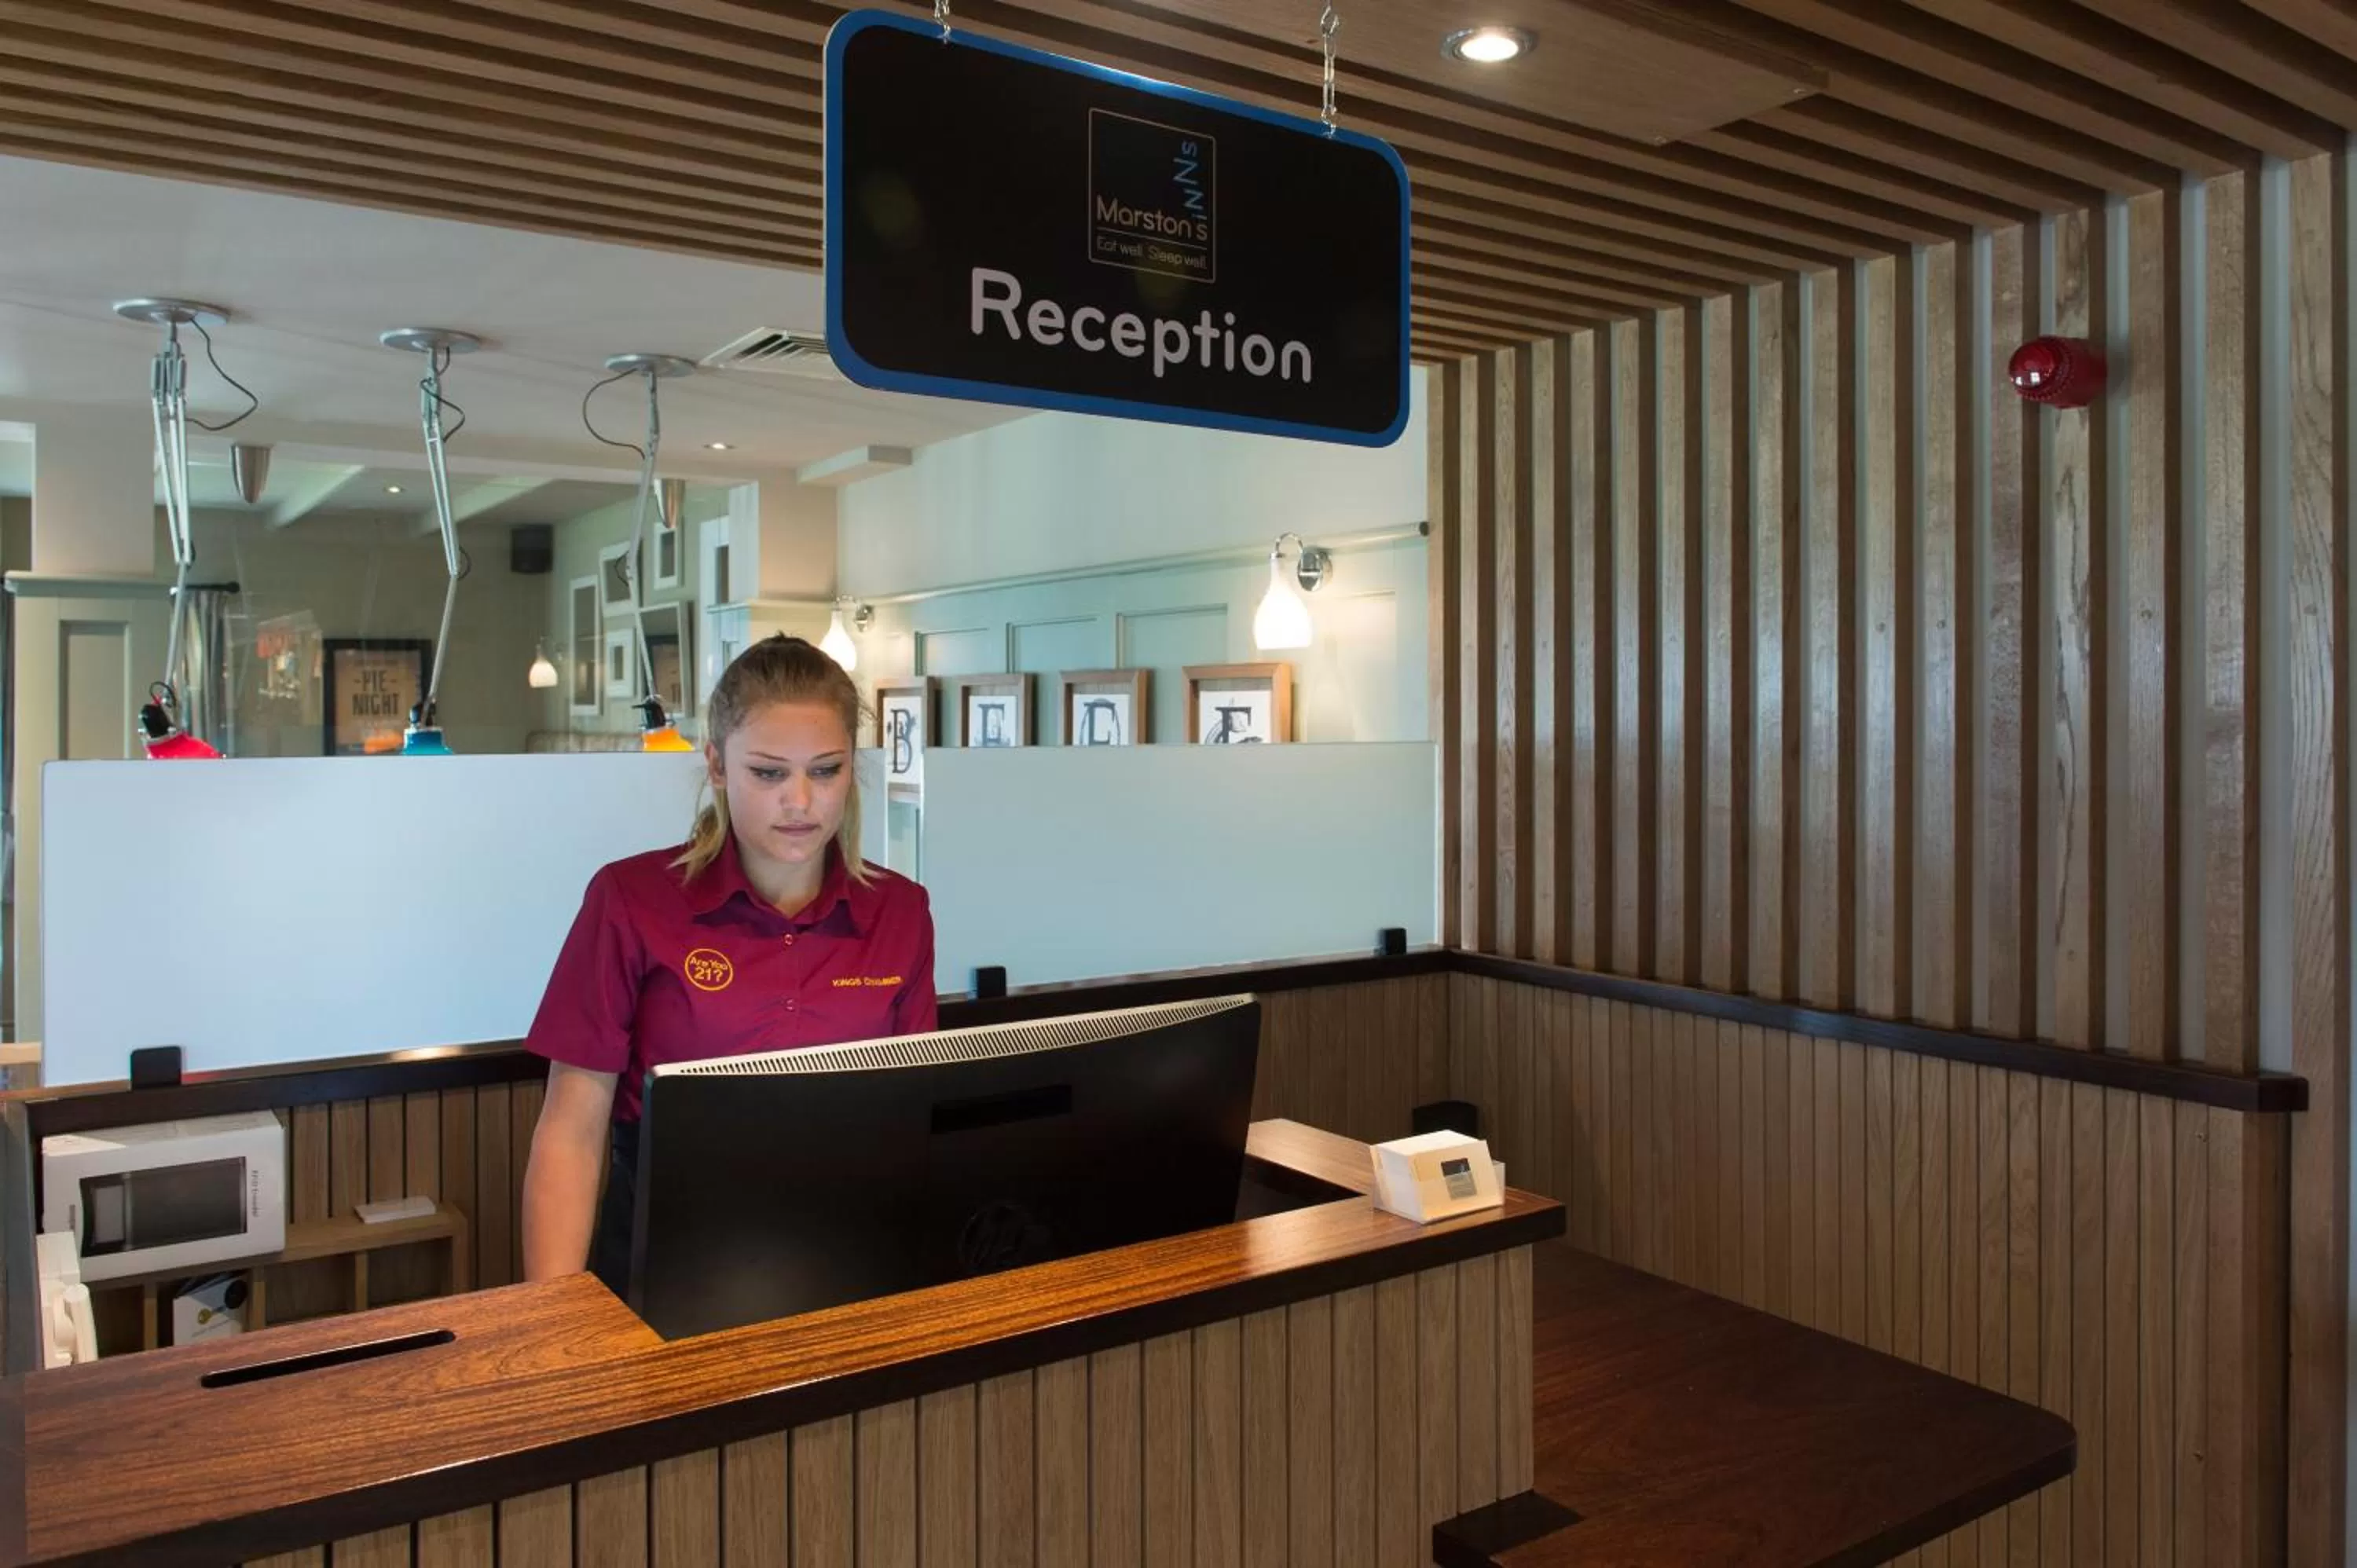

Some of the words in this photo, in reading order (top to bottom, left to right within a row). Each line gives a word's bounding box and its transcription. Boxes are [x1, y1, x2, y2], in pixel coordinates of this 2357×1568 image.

[1096, 235, 1117, 252] Eat
[1147, 244, 1182, 266] Sleep
[970, 266, 1312, 384] Reception
[352, 693, 399, 716] NIGHT
[694, 967, 723, 982] 21?
